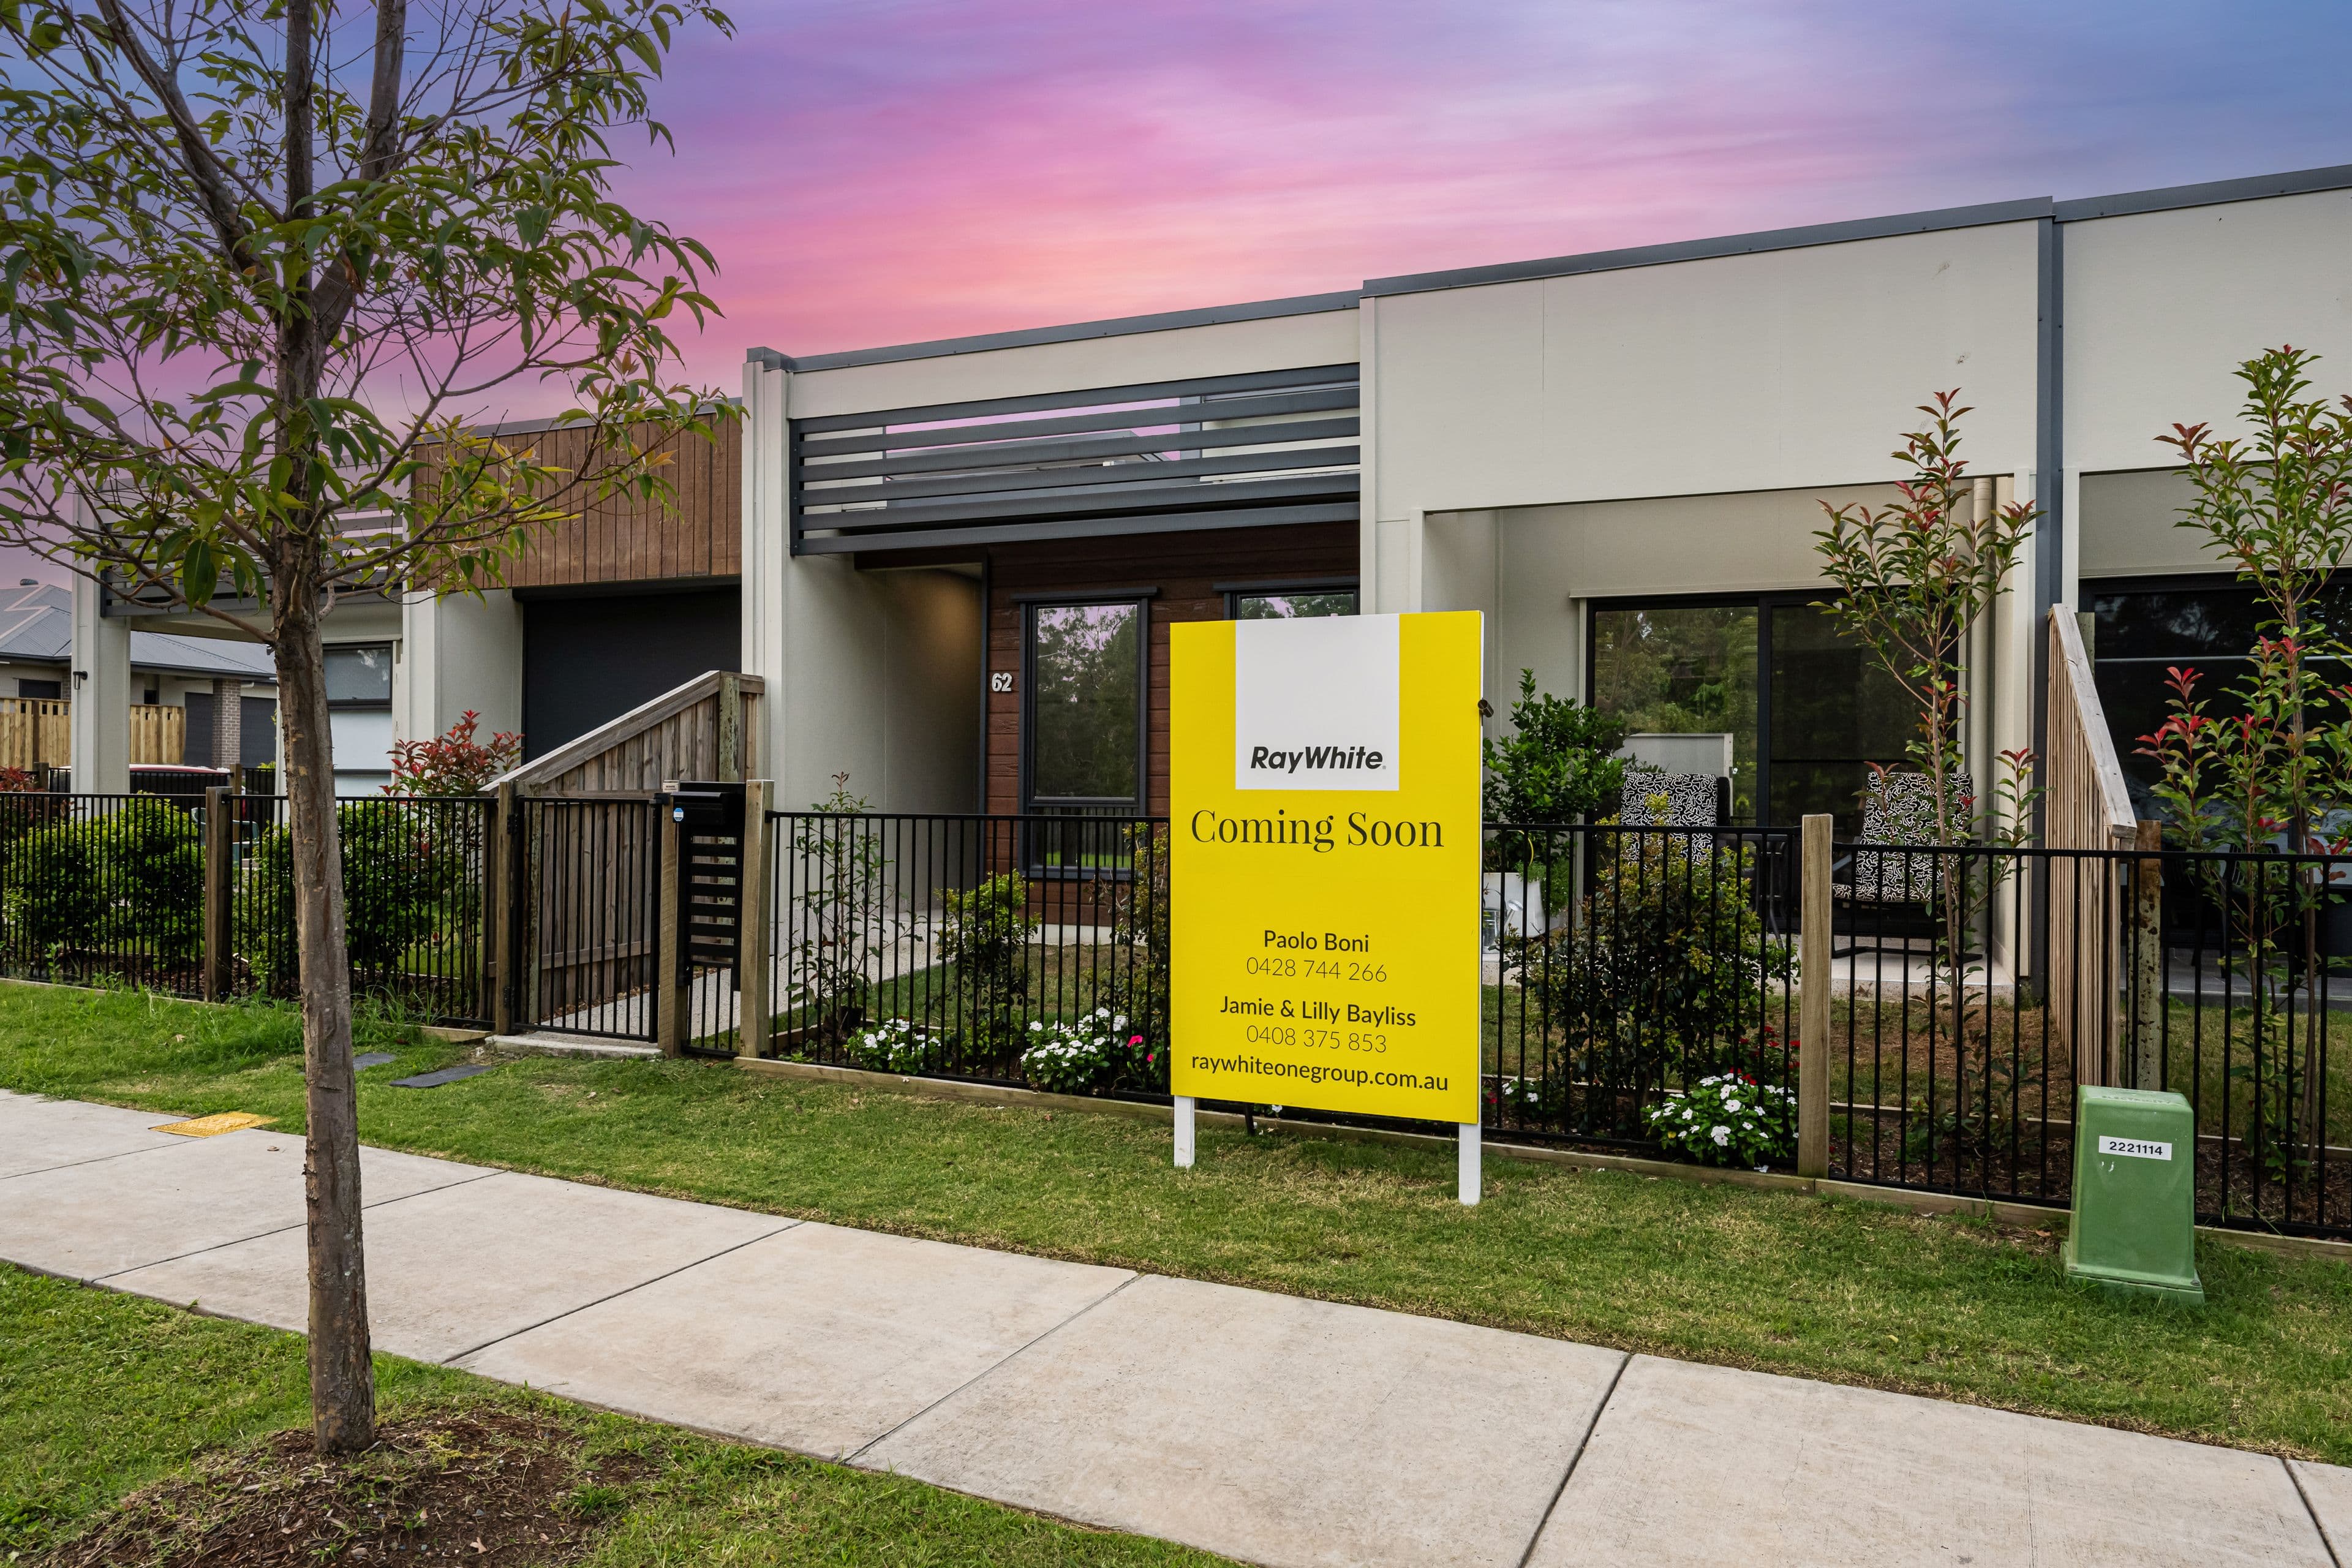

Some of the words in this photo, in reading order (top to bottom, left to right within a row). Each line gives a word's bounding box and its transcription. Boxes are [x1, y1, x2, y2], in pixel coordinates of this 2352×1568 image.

[992, 673, 1012, 692] 62
[1191, 809, 1335, 853] Coming
[1348, 812, 1445, 847] Soon
[1264, 930, 1317, 950] Paolo
[1325, 932, 1369, 952] Boni
[1246, 957, 1296, 977] 0428
[1303, 960, 1341, 980] 744
[1348, 962, 1387, 982] 266
[1220, 995, 1274, 1017] Jamie
[1280, 1000, 1295, 1018] &
[1302, 1000, 1341, 1025] Lilly
[1348, 1004, 1416, 1028] Bayliss
[1246, 1025, 1296, 1046] 0408
[1303, 1029, 1341, 1049] 375
[1348, 1033, 1387, 1053] 853
[1192, 1055, 1448, 1091] raywhiteonegroup.com.au
[2109, 1141, 2163, 1155] 2221114
